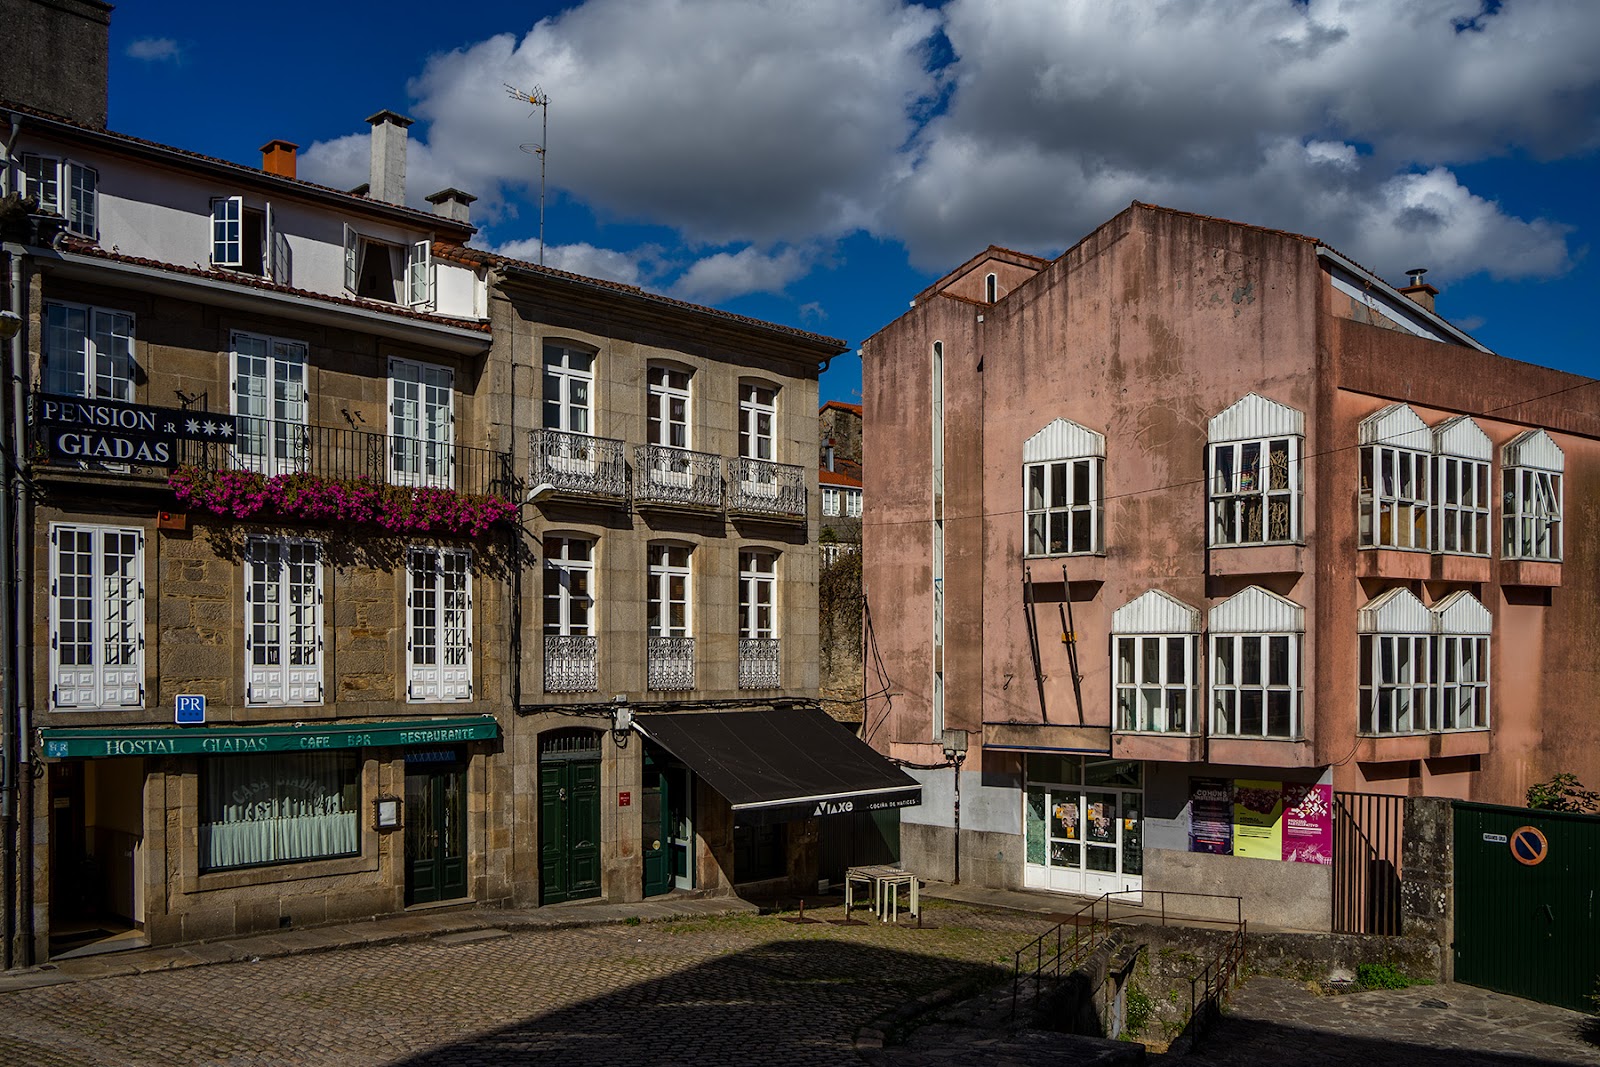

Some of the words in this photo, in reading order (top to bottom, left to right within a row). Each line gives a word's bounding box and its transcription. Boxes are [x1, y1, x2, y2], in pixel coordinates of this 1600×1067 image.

[43, 400, 157, 432] PENSION
[58, 433, 170, 463] GIADAS
[179, 697, 201, 711] PR
[106, 739, 182, 755] HOSTAL
[202, 737, 268, 753] GIADAS
[347, 734, 371, 746] BAR
[400, 728, 475, 743] RESTAURANTE
